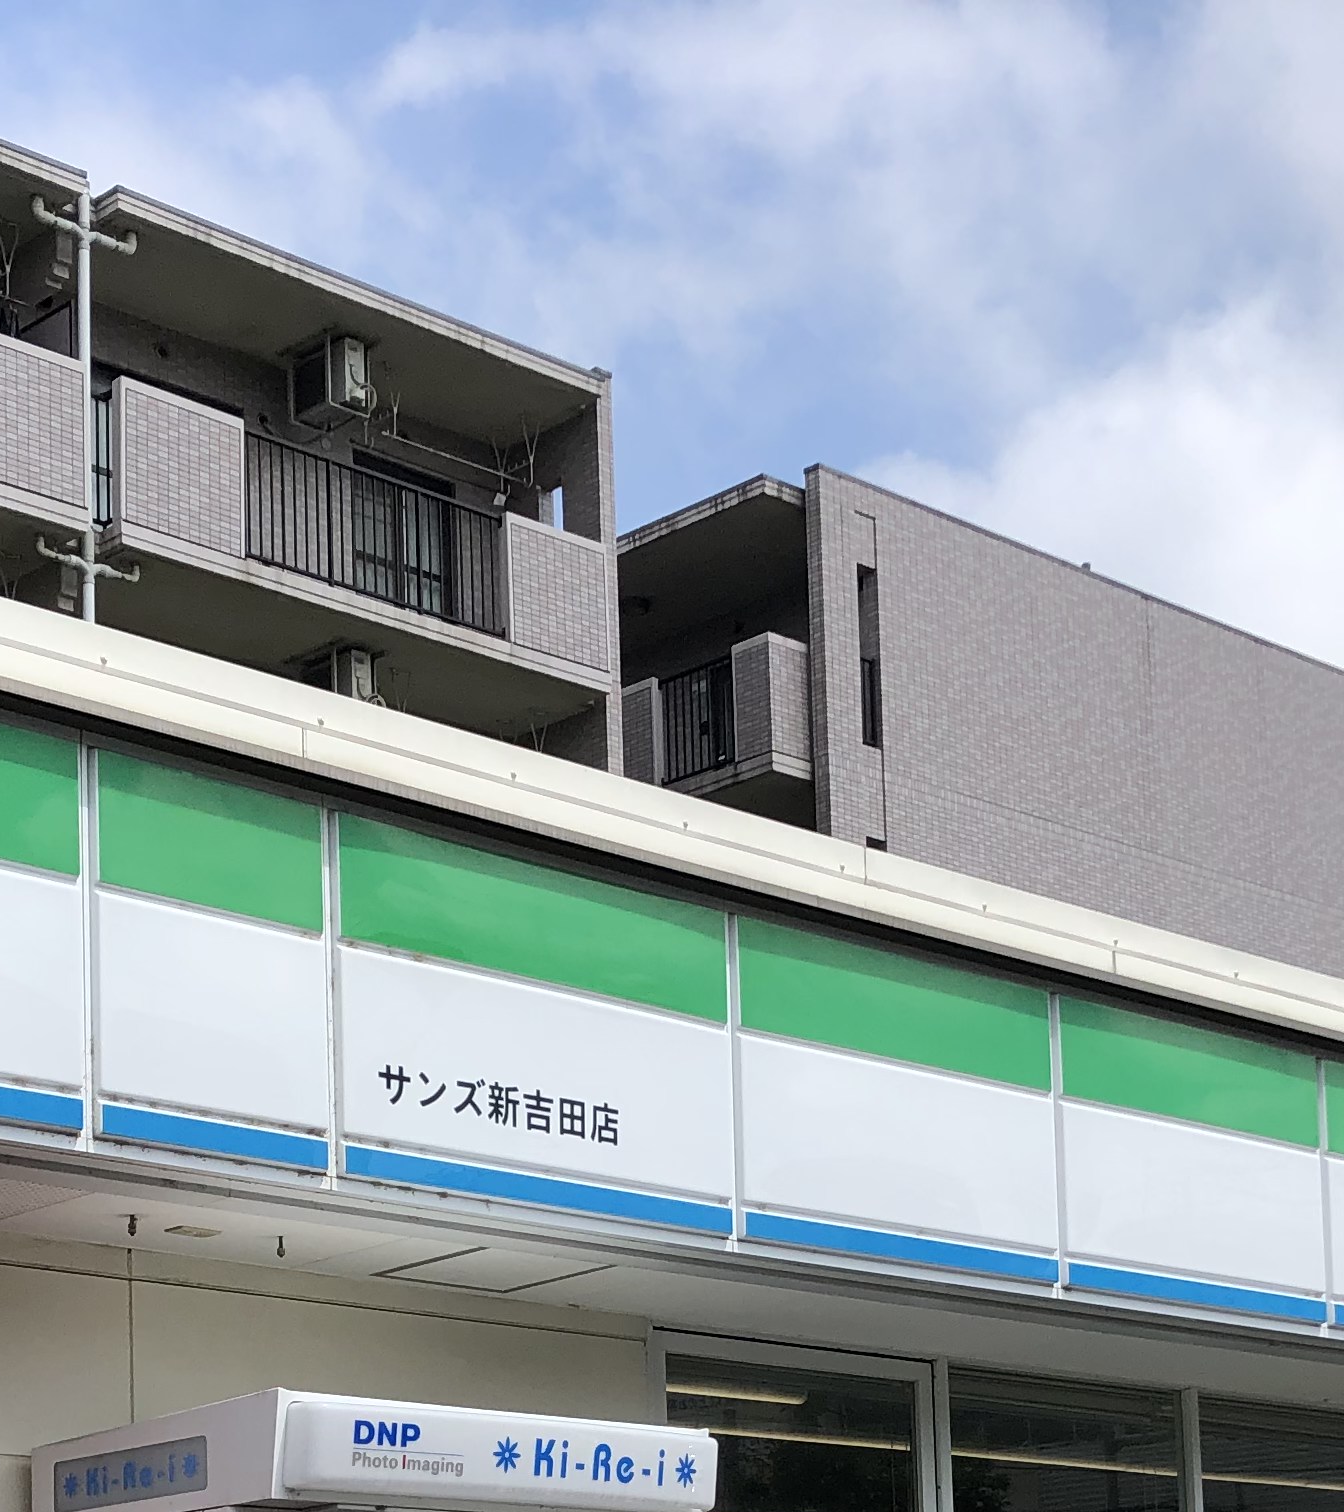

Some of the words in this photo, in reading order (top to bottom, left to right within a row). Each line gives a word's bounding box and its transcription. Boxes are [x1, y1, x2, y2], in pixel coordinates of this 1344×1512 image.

[378, 1063, 620, 1147] サンズ新吉田店
[352, 1419, 422, 1449] DNP
[351, 1451, 399, 1470] Photo
[402, 1454, 465, 1478] Imaging
[533, 1437, 666, 1487] Ki-Re-i
